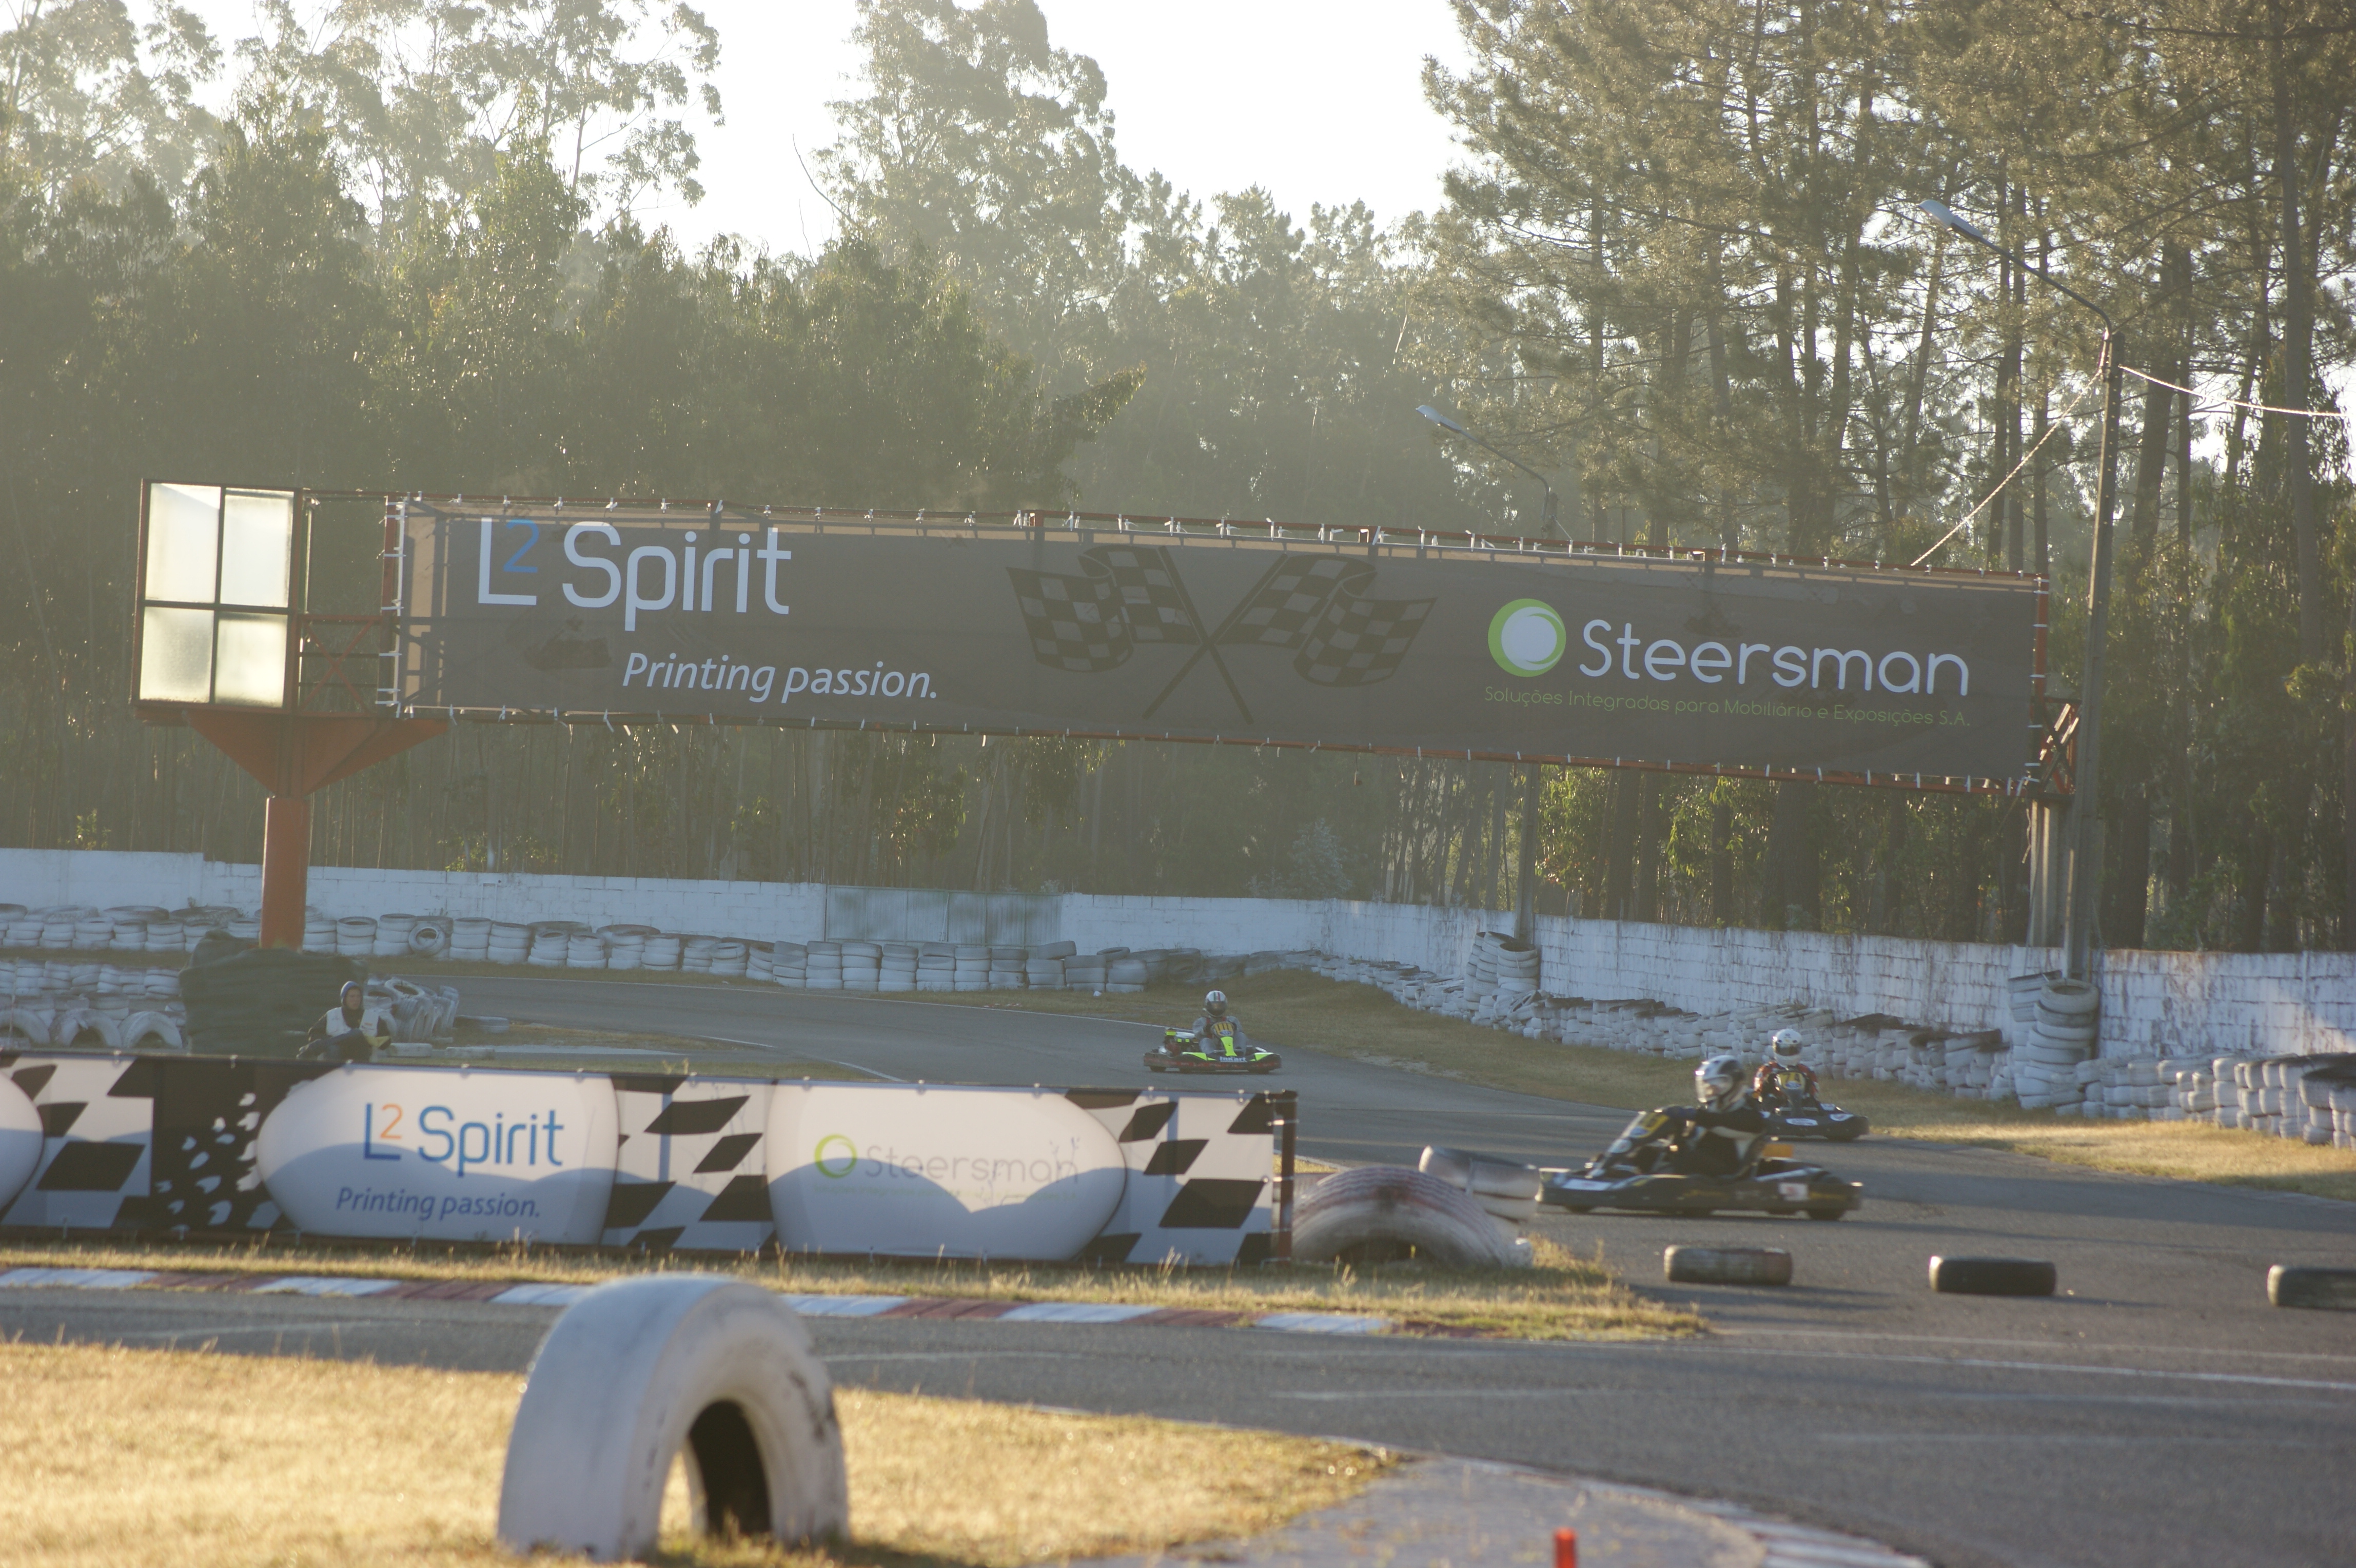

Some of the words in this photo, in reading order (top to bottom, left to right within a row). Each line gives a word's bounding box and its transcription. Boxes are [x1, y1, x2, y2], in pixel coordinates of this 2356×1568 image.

[562, 521, 792, 632] Spirit
[622, 652, 776, 703] Printing
[781, 661, 937, 704] passion.
[1579, 619, 1969, 696] Steersman
[1484, 685, 1563, 708] Soluções
[1568, 690, 1670, 712] Integradas
[1674, 700, 1719, 715] para
[1724, 699, 1813, 718] Mobiliário
[1816, 708, 1829, 719] e
[1833, 704, 1934, 727] Exposições
[1939, 710, 1970, 727] S.A.
[418, 1106, 564, 1178] Spirit
[865, 1145, 1078, 1183] Steersman
[336, 1186, 437, 1221] Printing
[439, 1192, 541, 1221] passion.
